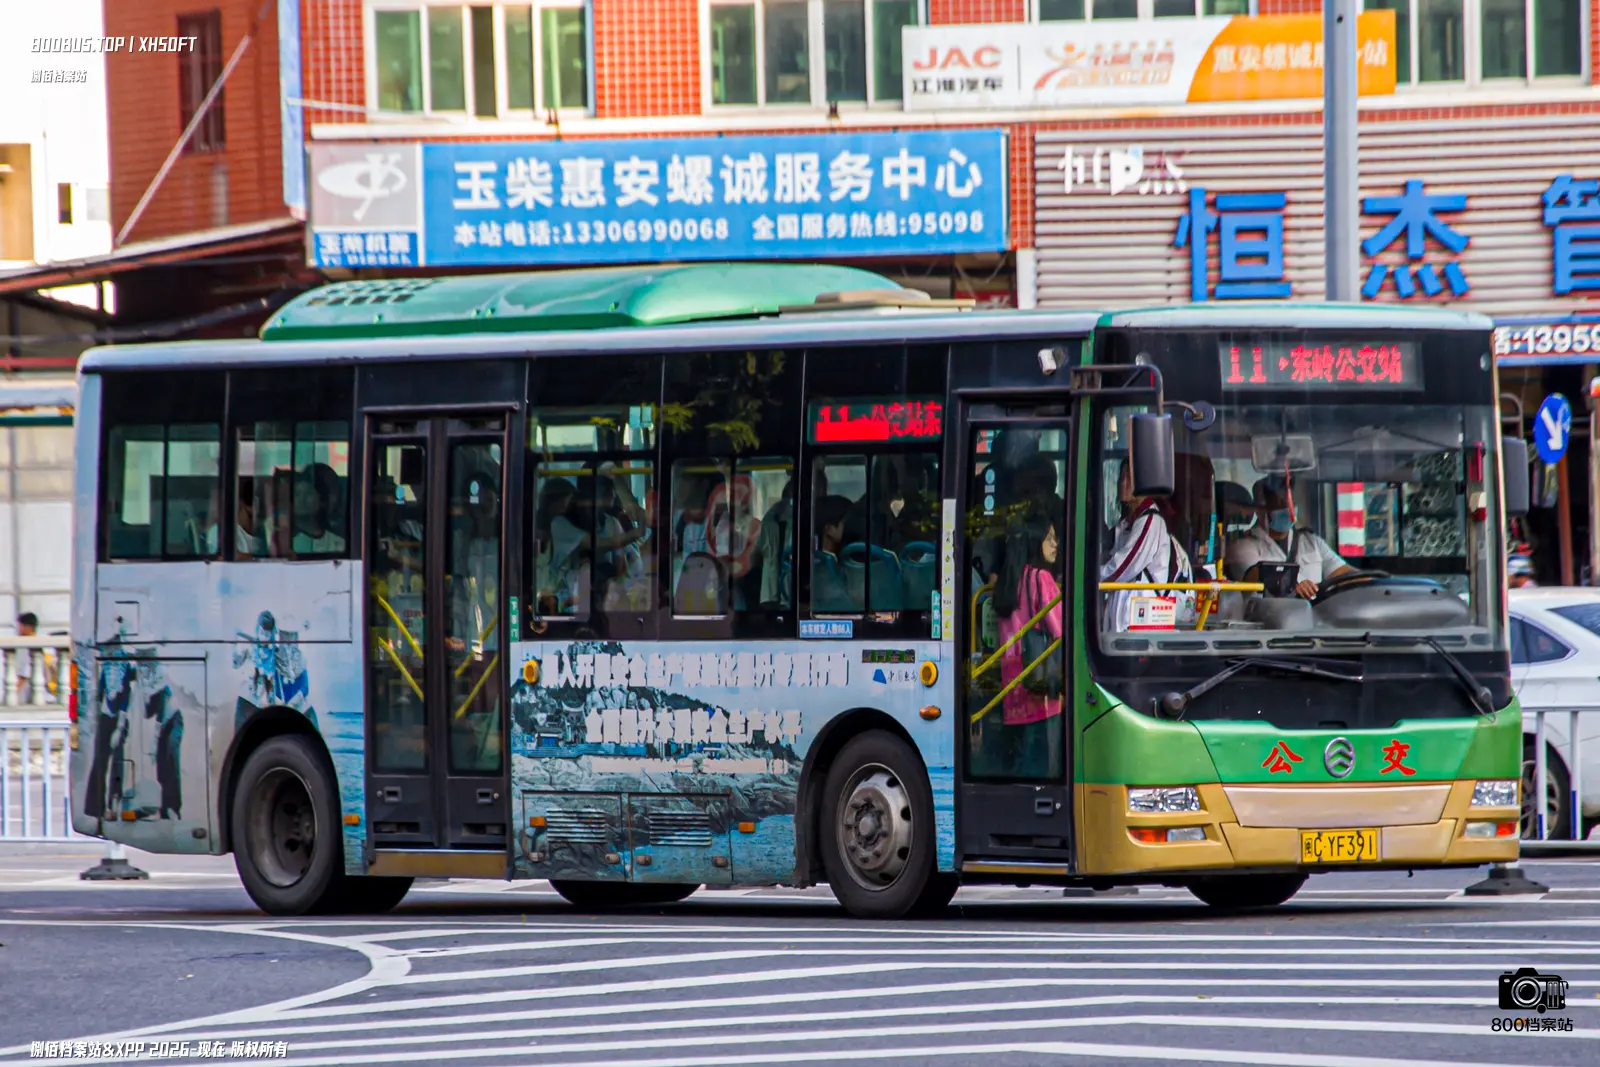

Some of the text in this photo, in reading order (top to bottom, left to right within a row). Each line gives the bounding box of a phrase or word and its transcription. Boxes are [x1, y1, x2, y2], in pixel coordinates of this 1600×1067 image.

[912, 46, 1002, 70] JAC
[1213, 38, 1389, 73] 惠安螺诚站
[452, 147, 983, 210] 玉柴惠安螺诚服务中心
[454, 217, 729, 247] 本站电话:13306990068
[752, 211, 984, 241] 全国服务热线:95098
[1227, 344, 1403, 383] 11 东岭公交站
[1262, 739, 1417, 776] 公 交
